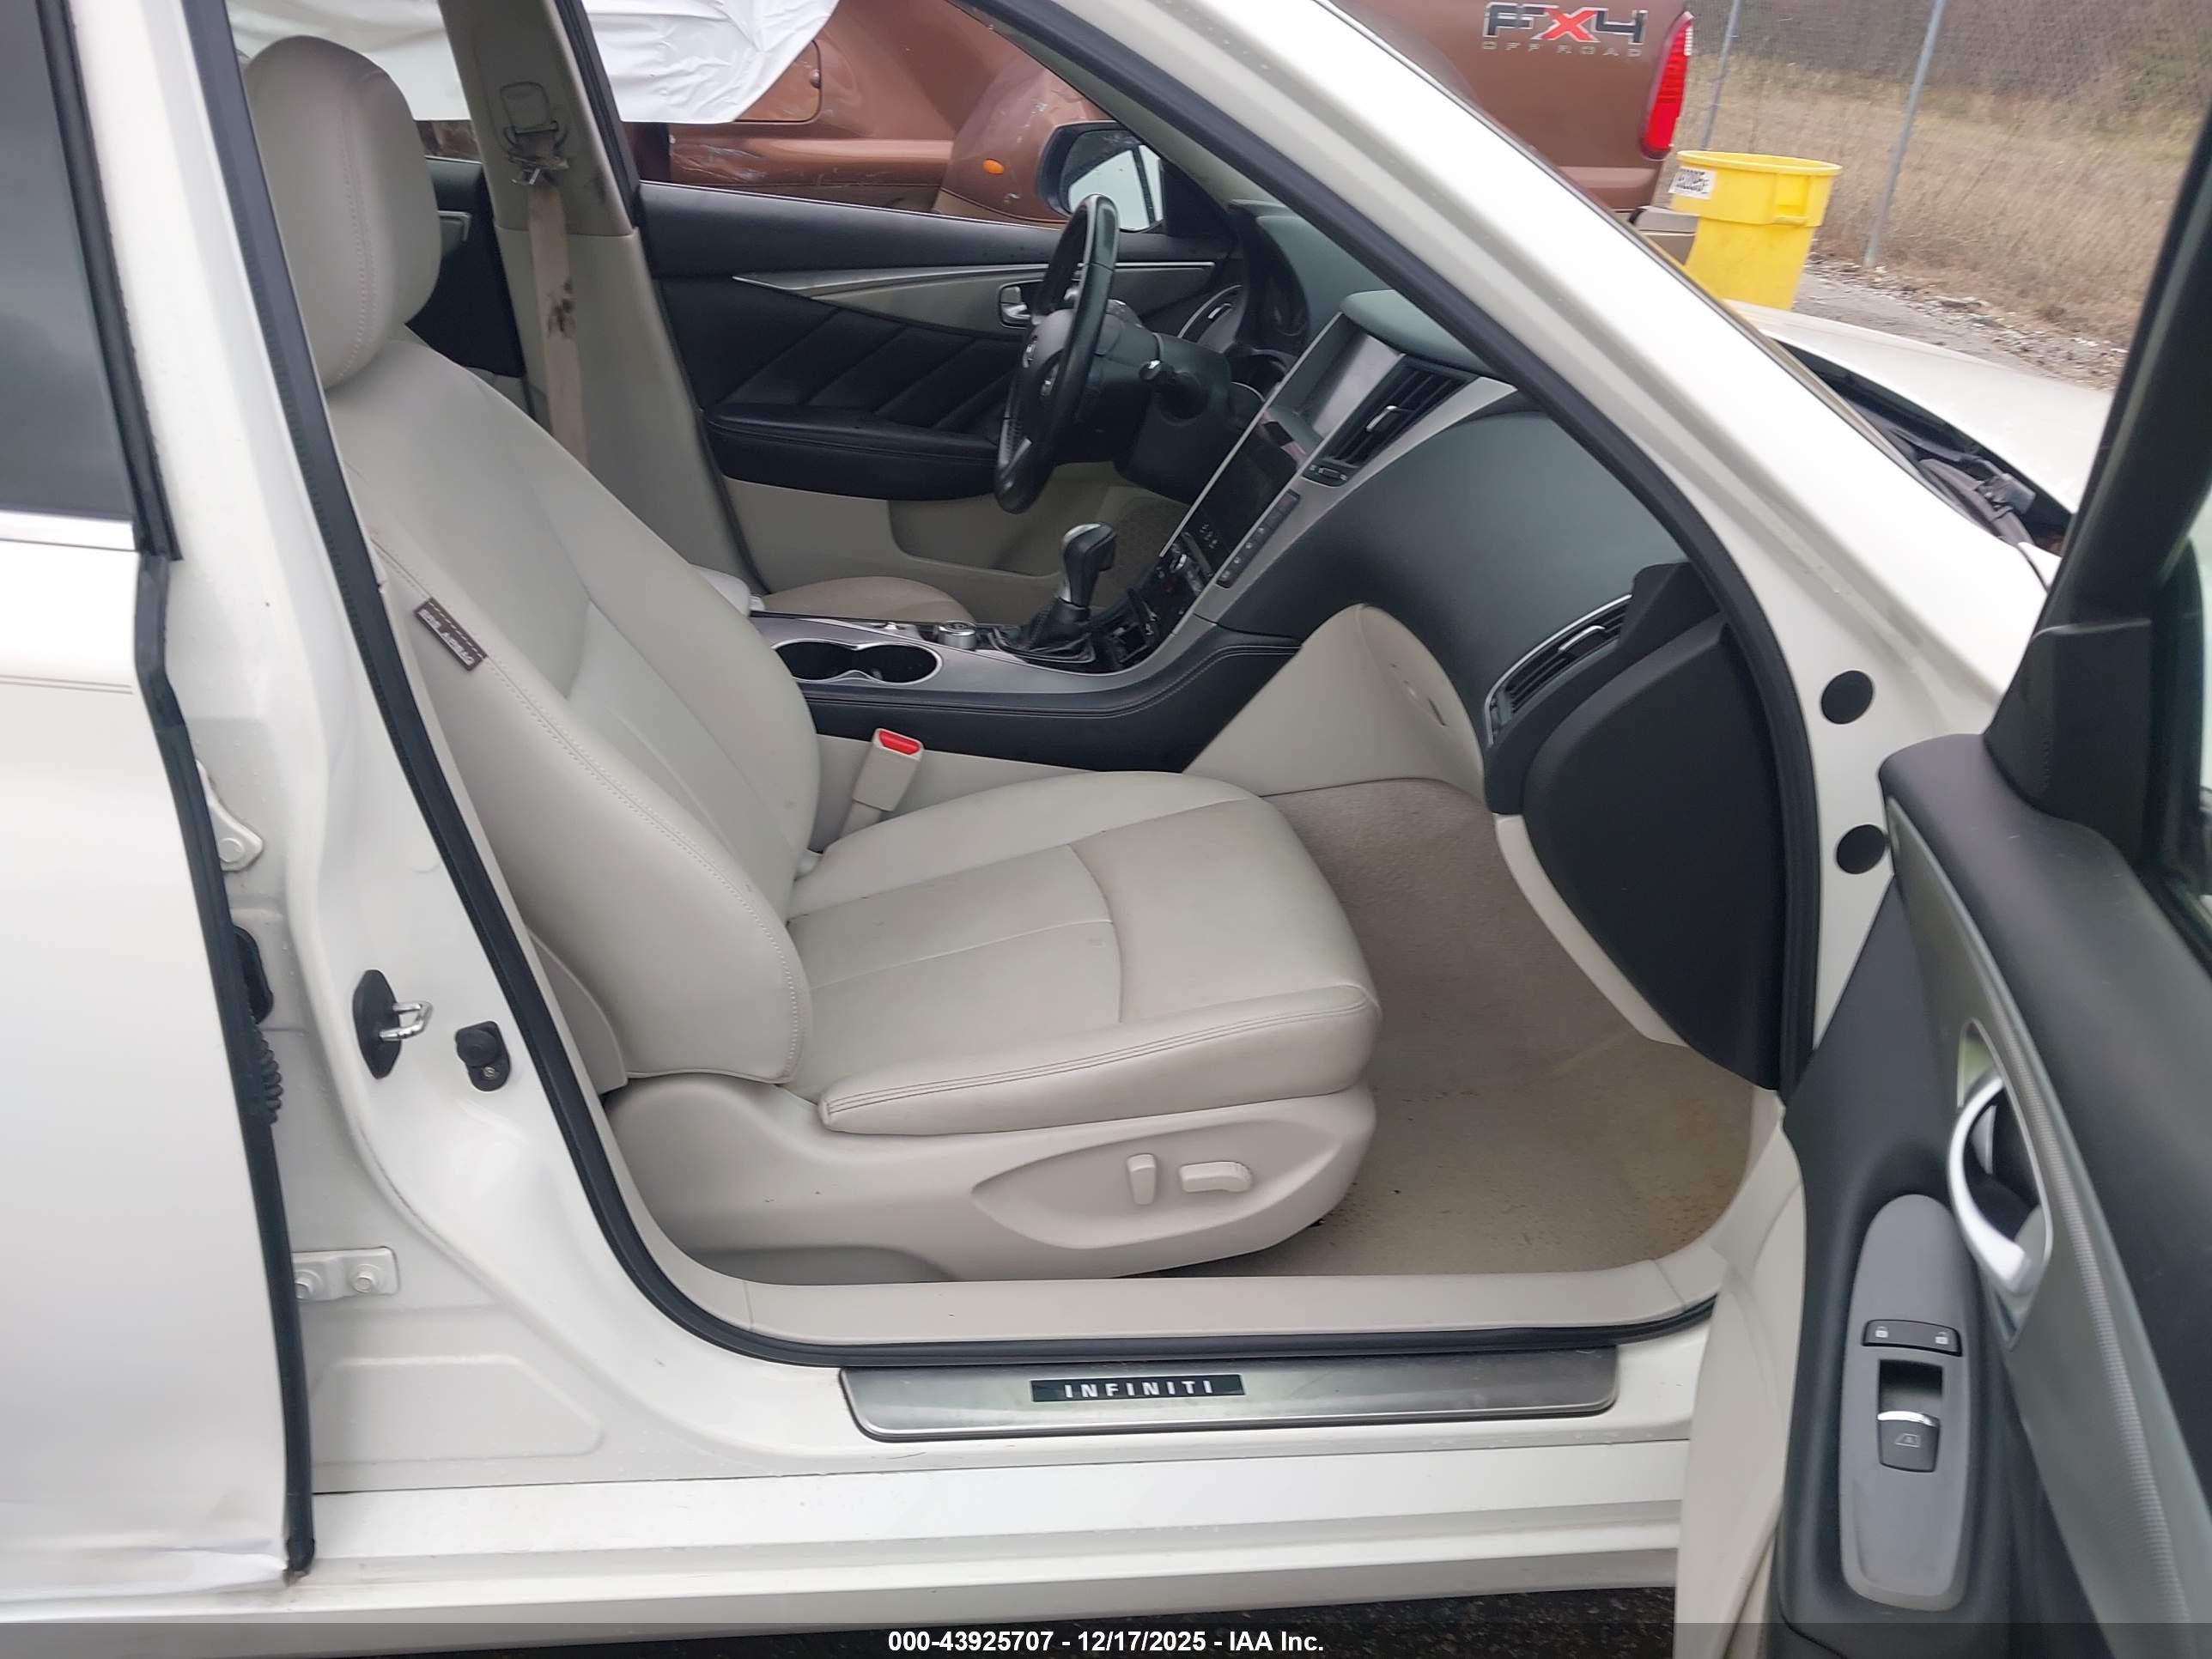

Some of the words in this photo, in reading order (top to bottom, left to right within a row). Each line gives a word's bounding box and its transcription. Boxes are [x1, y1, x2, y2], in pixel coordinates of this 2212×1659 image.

[1483, 2, 1648, 45] FX4
[1482, 41, 1540, 52] OFF
[1556, 45, 1643, 58] ROAD
[1064, 1380, 1213, 1398] INFINITI
